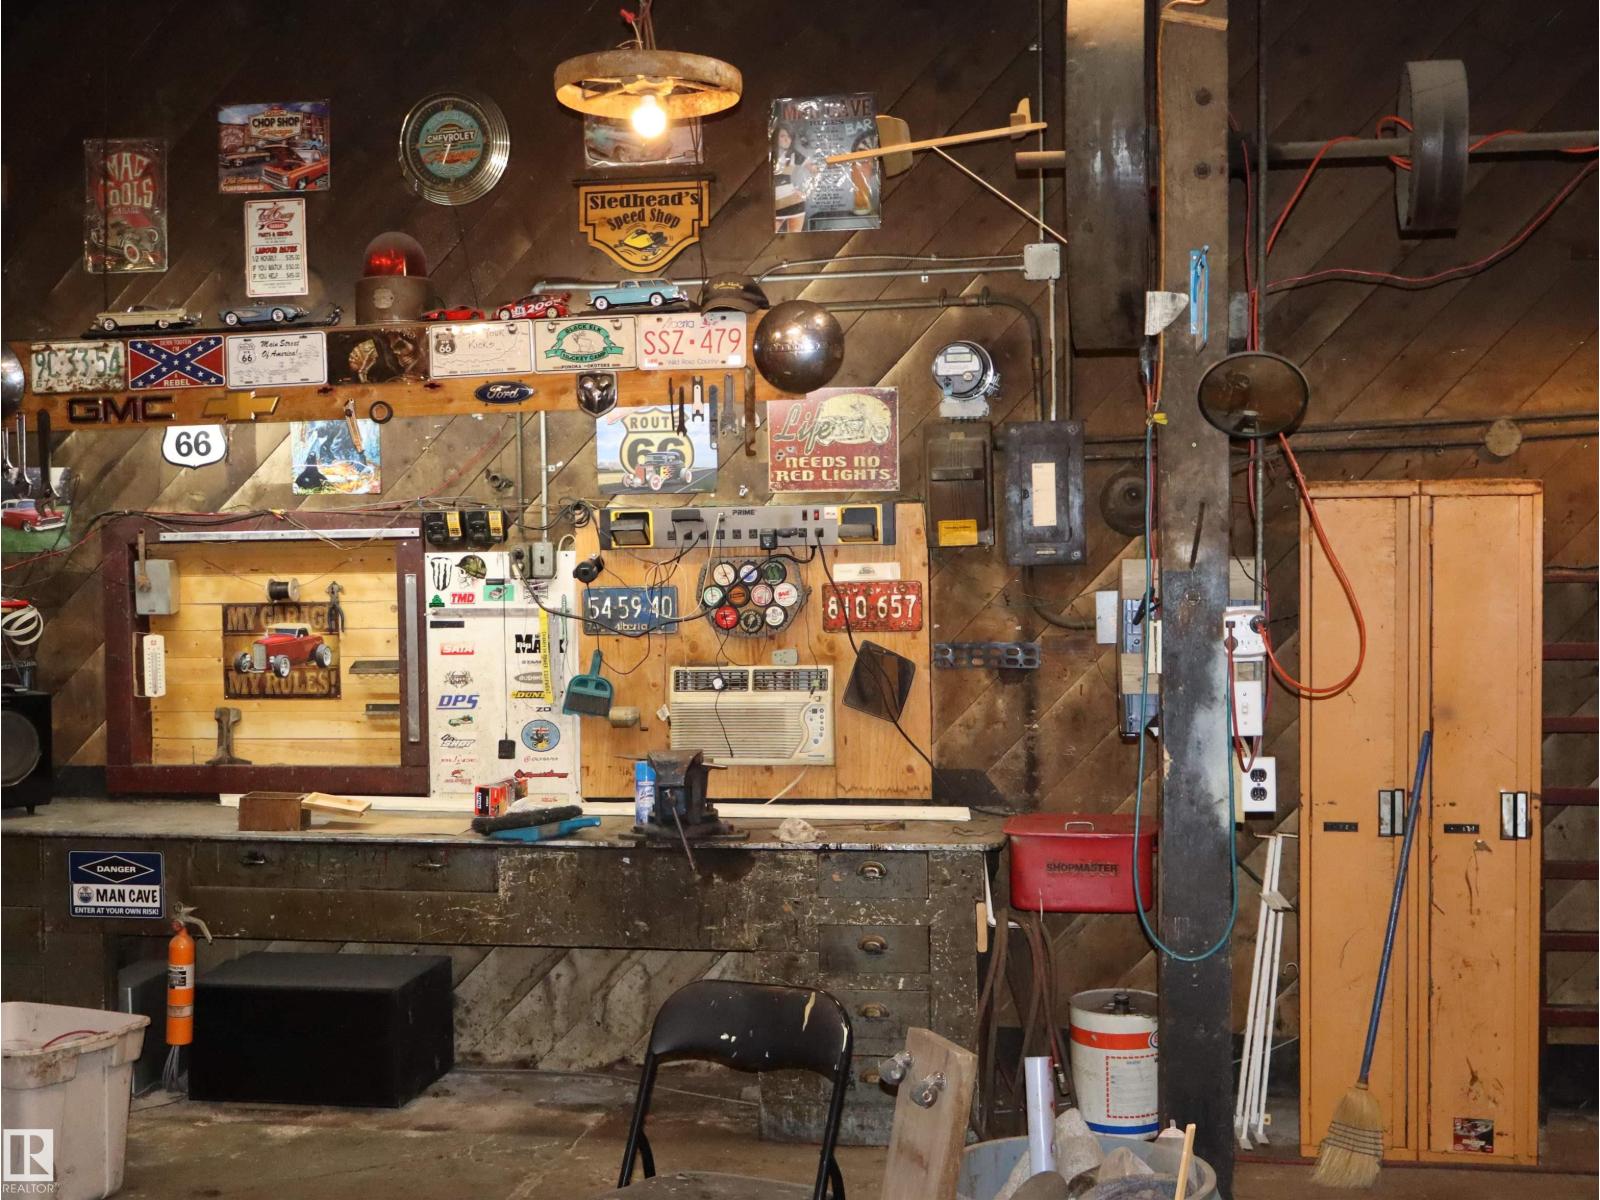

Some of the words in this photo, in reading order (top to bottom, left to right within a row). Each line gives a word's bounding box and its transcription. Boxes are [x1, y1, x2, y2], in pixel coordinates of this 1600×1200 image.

[252, 118, 275, 128] CHOP
[277, 117, 299, 127] SHOP
[845, 118, 873, 136] BAR
[427, 131, 475, 143] CHEVROLET
[589, 191, 699, 209] Sledhead's
[607, 209, 646, 231] Speed
[650, 208, 681, 229] Shop
[565, 325, 587, 333] BLACK
[439, 344, 452, 353] 66
[486, 384, 520, 399] Ford
[67, 394, 177, 424] GMC
[773, 402, 833, 456] Life
[175, 430, 212, 457] 66
[627, 438, 686, 468] 66
[785, 455, 847, 468] NEEDS
[853, 455, 881, 468] NO
[773, 470, 815, 482] RED
[821, 469, 891, 481] LIGHTS
[451, 593, 475, 603] TMD
[227, 606, 257, 631] MY
[228, 669, 260, 695] MY
[265, 669, 337, 695] RULES!
[97, 865, 136, 873] DANGER
[1046, 863, 1119, 872] SHOPMASTER
[96, 888, 125, 903] MAN
[128, 889, 158, 903] CAVE
